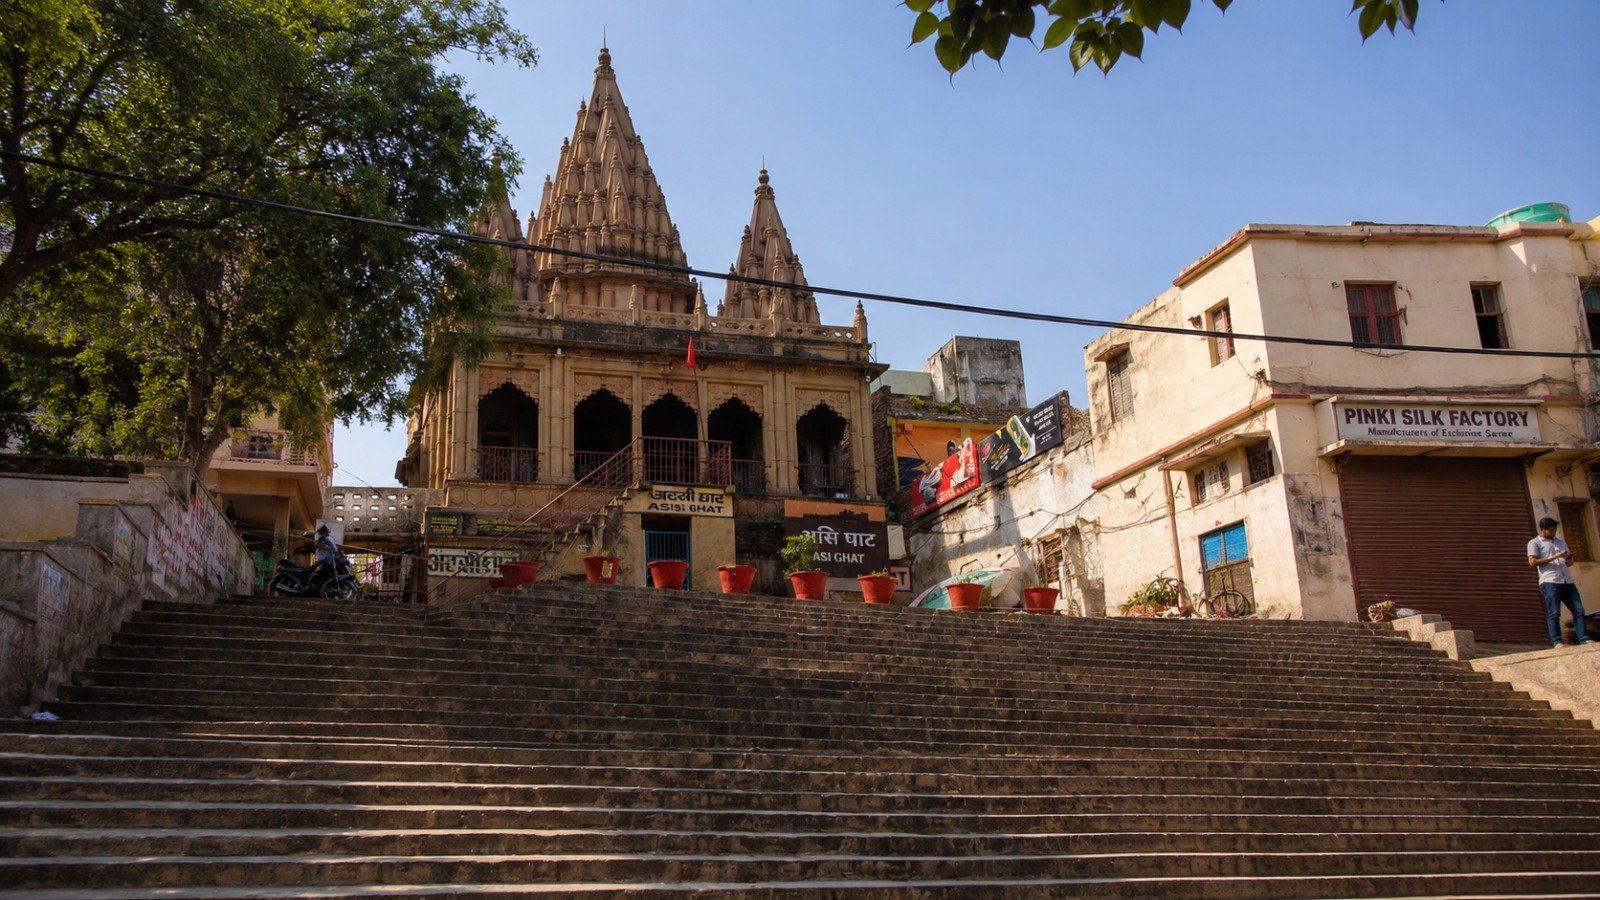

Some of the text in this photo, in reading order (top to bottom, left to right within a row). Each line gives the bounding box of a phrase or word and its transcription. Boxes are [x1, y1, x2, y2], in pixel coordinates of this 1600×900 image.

[1344, 408, 1528, 427] PINKI SILK FACTORY
[689, 504, 725, 514] GHAT
[843, 532, 877, 547] घाट
[812, 551, 865, 564] ASI GHAT
